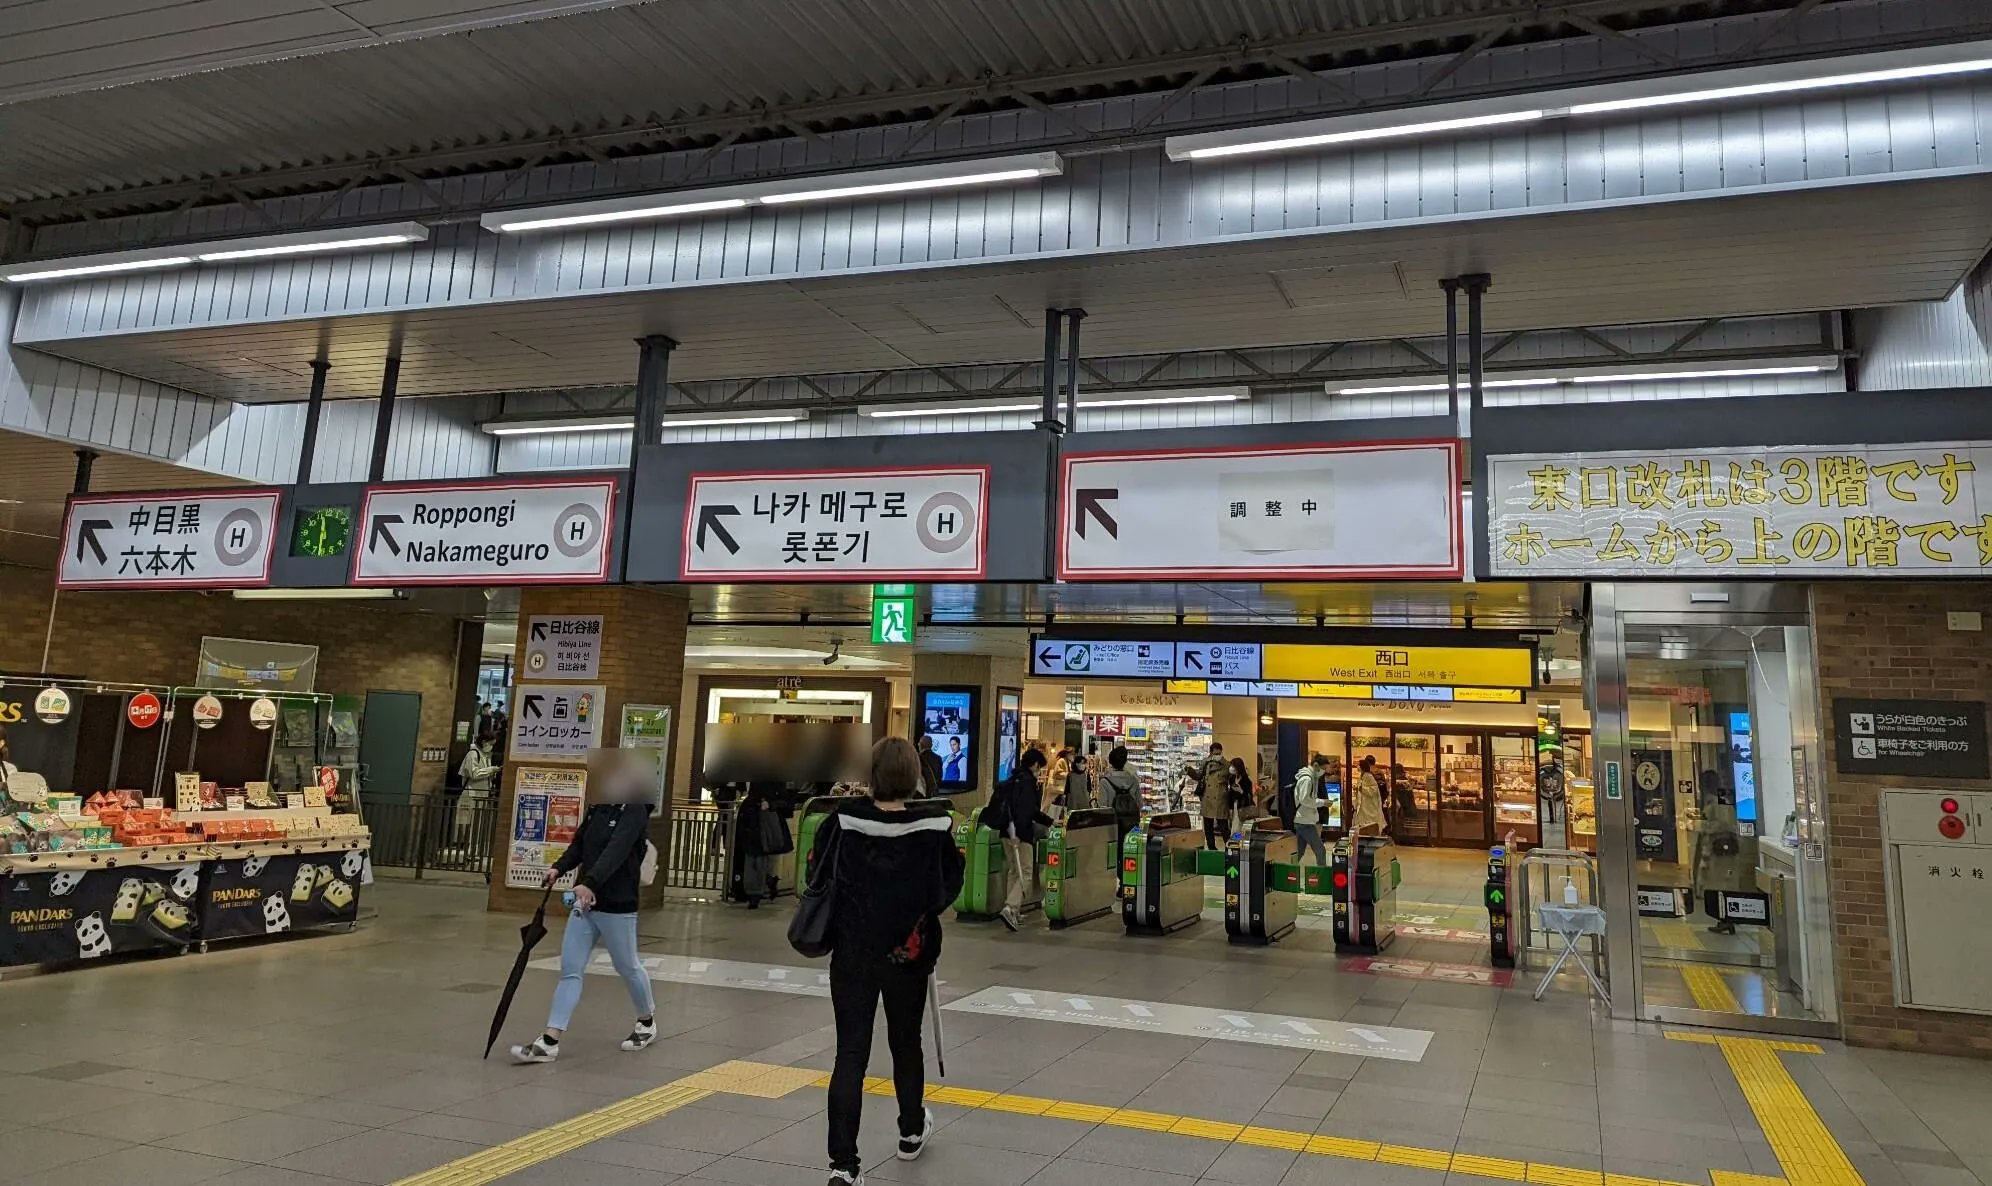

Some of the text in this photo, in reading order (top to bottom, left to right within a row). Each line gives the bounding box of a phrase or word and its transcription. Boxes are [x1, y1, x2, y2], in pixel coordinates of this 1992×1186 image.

[1527, 453, 1976, 512] 東口改札は3階です
[412, 499, 516, 529] Roppongi
[753, 491, 908, 523] 나카 메구로
[1230, 499, 1317, 518] 調整中
[128, 504, 200, 536] 中目黒
[937, 513, 954, 534] H
[230, 527, 246, 548] H
[570, 522, 585, 540] H
[1503, 513, 1992, 566] ホームから上の階です
[406, 540, 549, 566] Nakameguro
[782, 530, 870, 563] 롯폰기
[118, 544, 197, 576] 六本木
[550, 620, 600, 635] 日比谷線
[534, 657, 541, 666] H
[1375, 650, 1408, 666] 西口
[1330, 668, 1355, 677] West
[1358, 669, 1377, 678] Exit
[518, 725, 592, 738] コインロッカー
[1049, 854, 1059, 865] IC
[1125, 859, 1136, 871] IC
[1928, 866, 1985, 880] 消火栓
[212, 888, 261, 903] PANDARS
[10, 908, 73, 925] PANDARS
